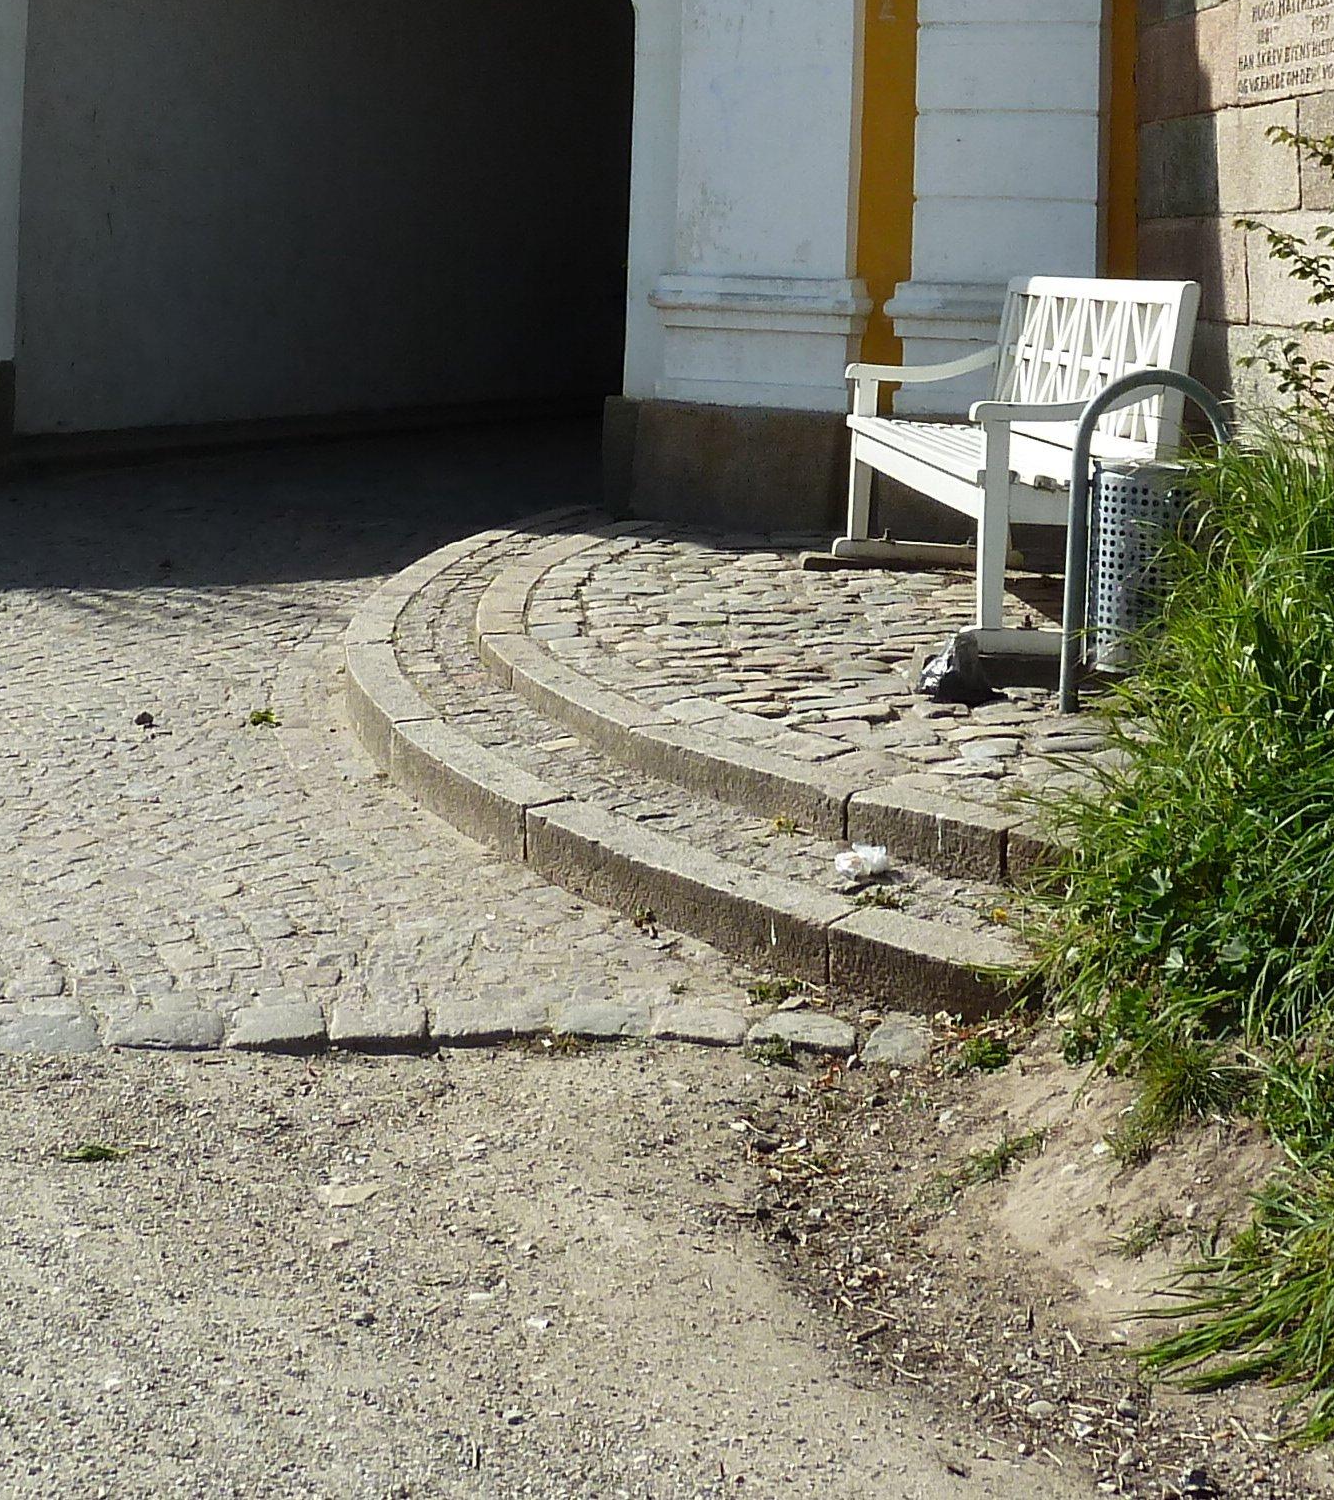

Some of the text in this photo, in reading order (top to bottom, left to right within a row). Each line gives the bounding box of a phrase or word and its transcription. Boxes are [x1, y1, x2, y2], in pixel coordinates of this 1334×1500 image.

[1252, 0, 1275, 22] HUGO
[1238, 53, 1254, 71] HAN
[1257, 46, 1282, 68] SKREV
